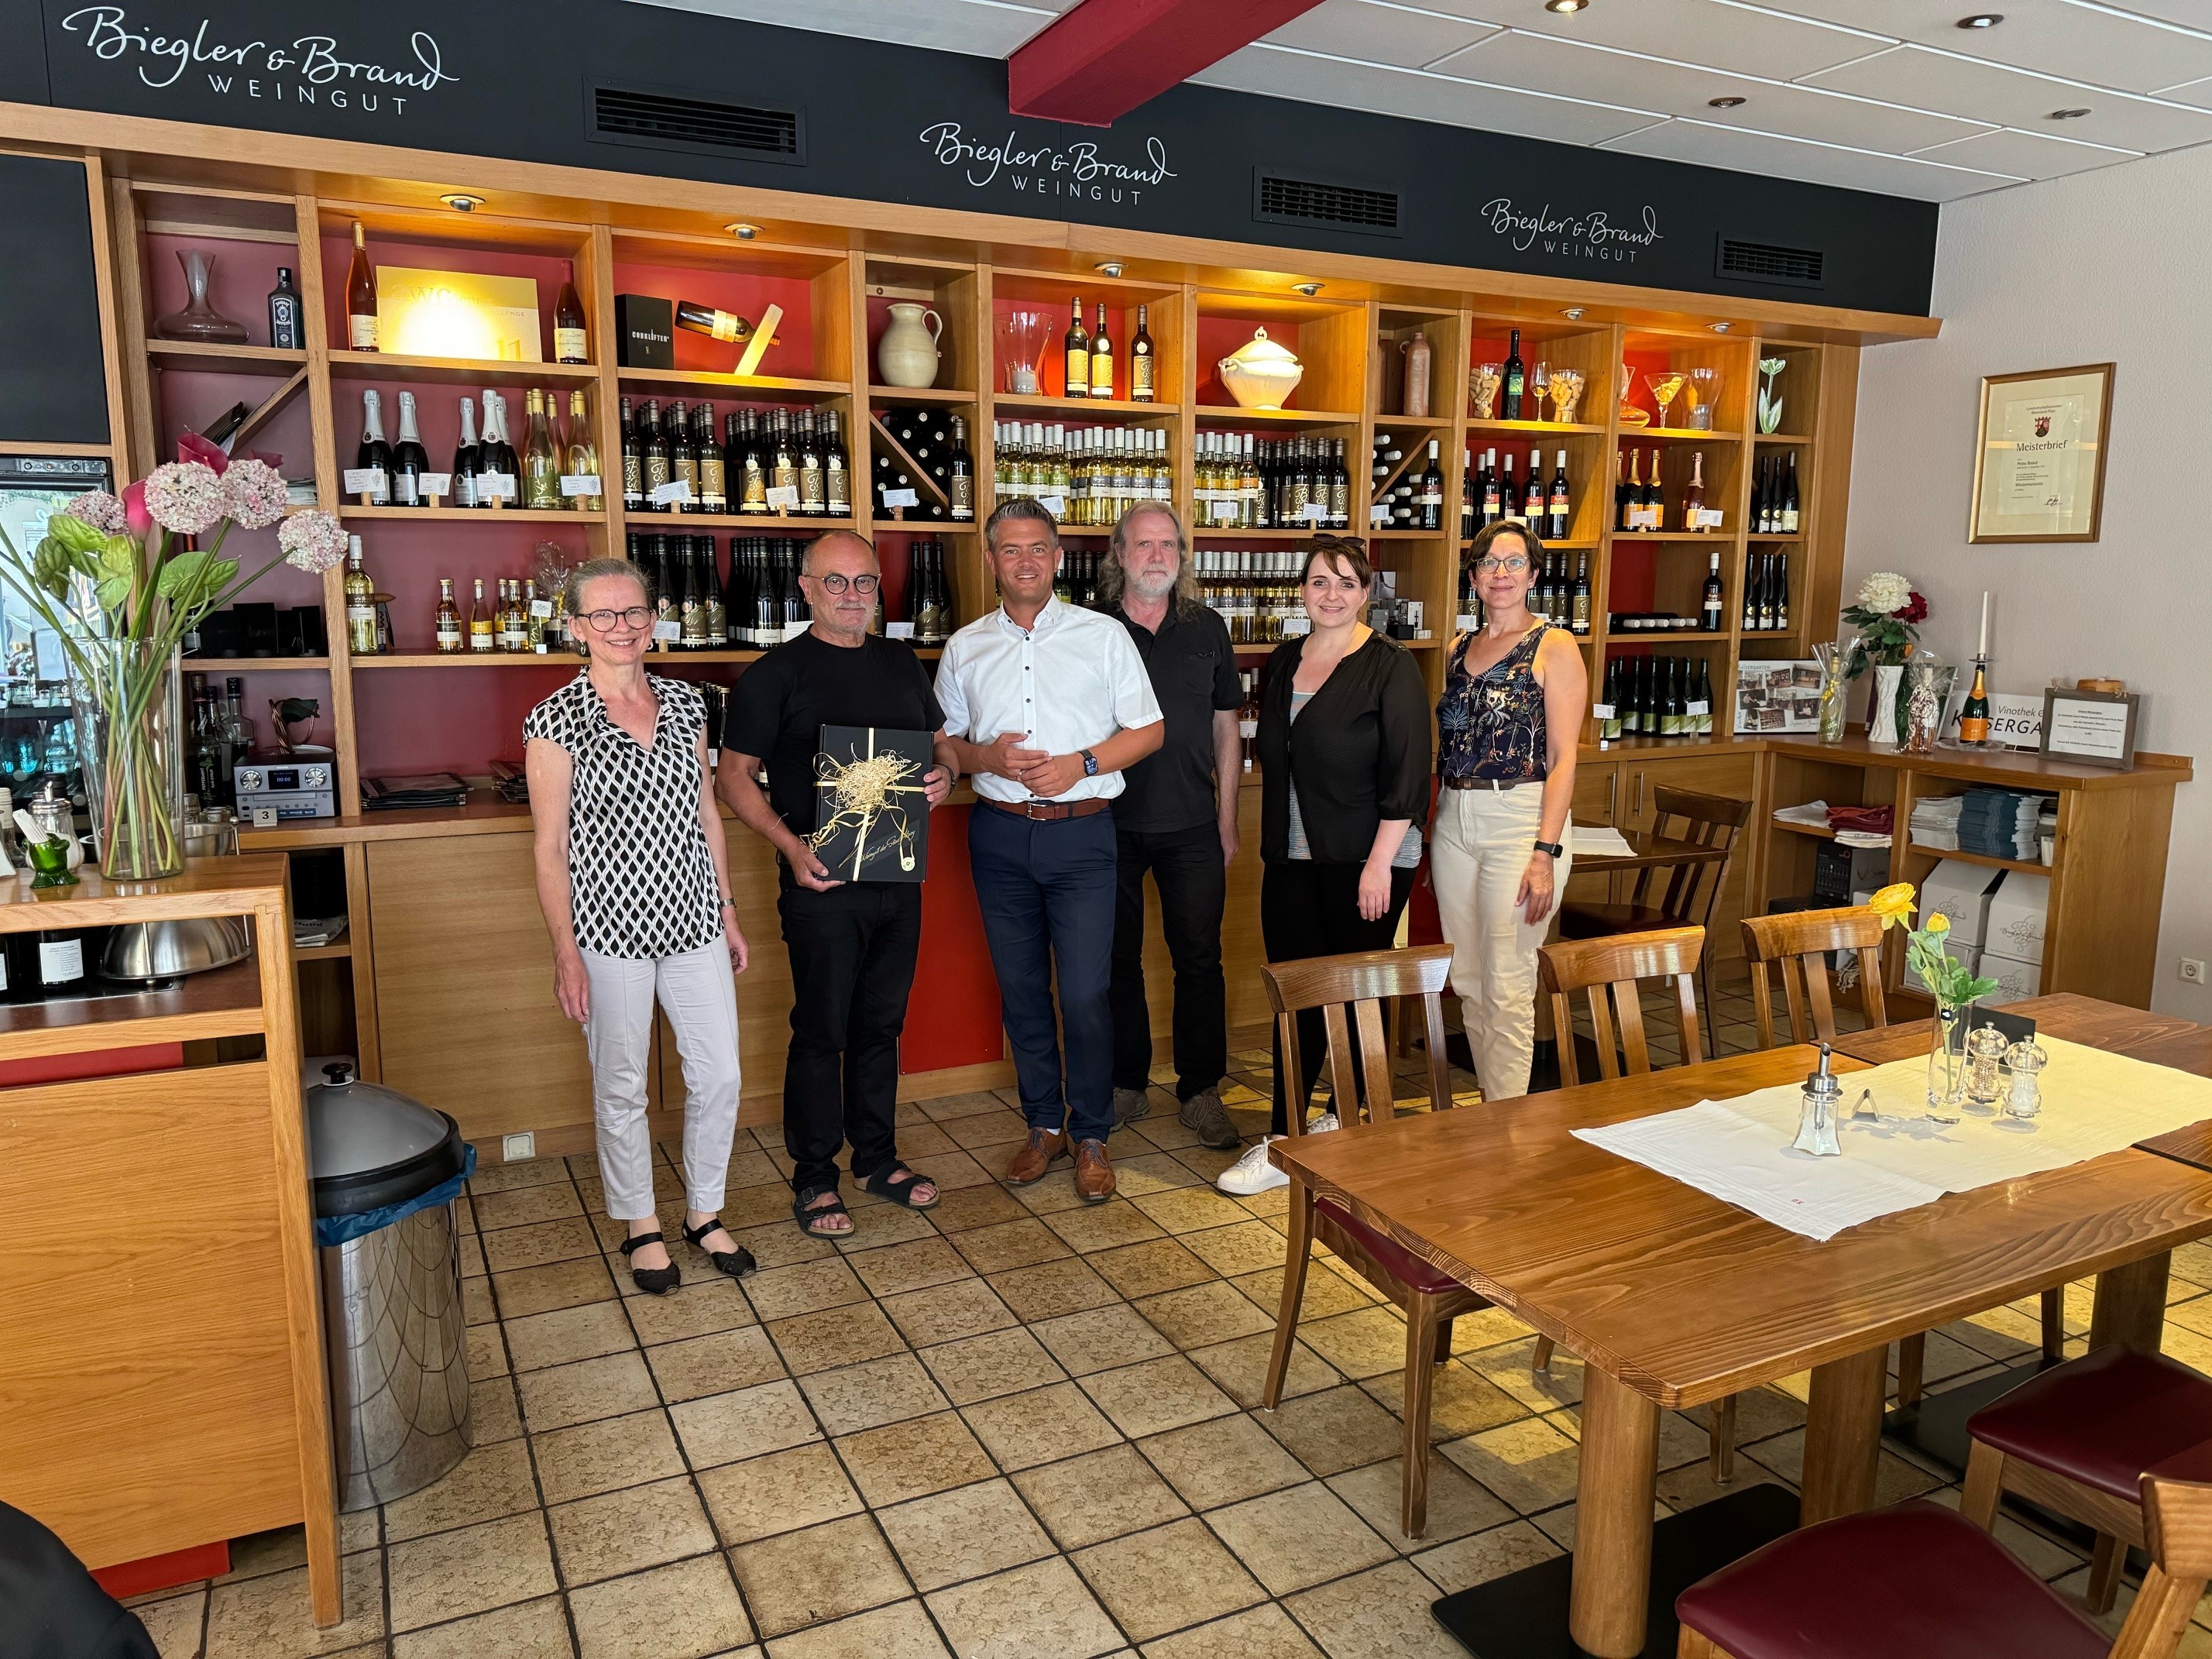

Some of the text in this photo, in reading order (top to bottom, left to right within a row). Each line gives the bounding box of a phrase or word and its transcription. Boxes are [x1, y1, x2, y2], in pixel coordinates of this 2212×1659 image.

[62, 6, 460, 91] Biegler & Brand
[208, 74, 407, 115] WEINGUT
[919, 122, 1178, 187] Biegler & Brand
[1012, 174, 1142, 205] WEINGUT
[1481, 198, 1664, 251] Biegler & Brand
[1544, 240, 1637, 263] WEINGUT
[2016, 439, 2068, 452] Meisterbrief
[1998, 706, 2035, 716] Vinothek
[262, 811, 270, 819] 3
